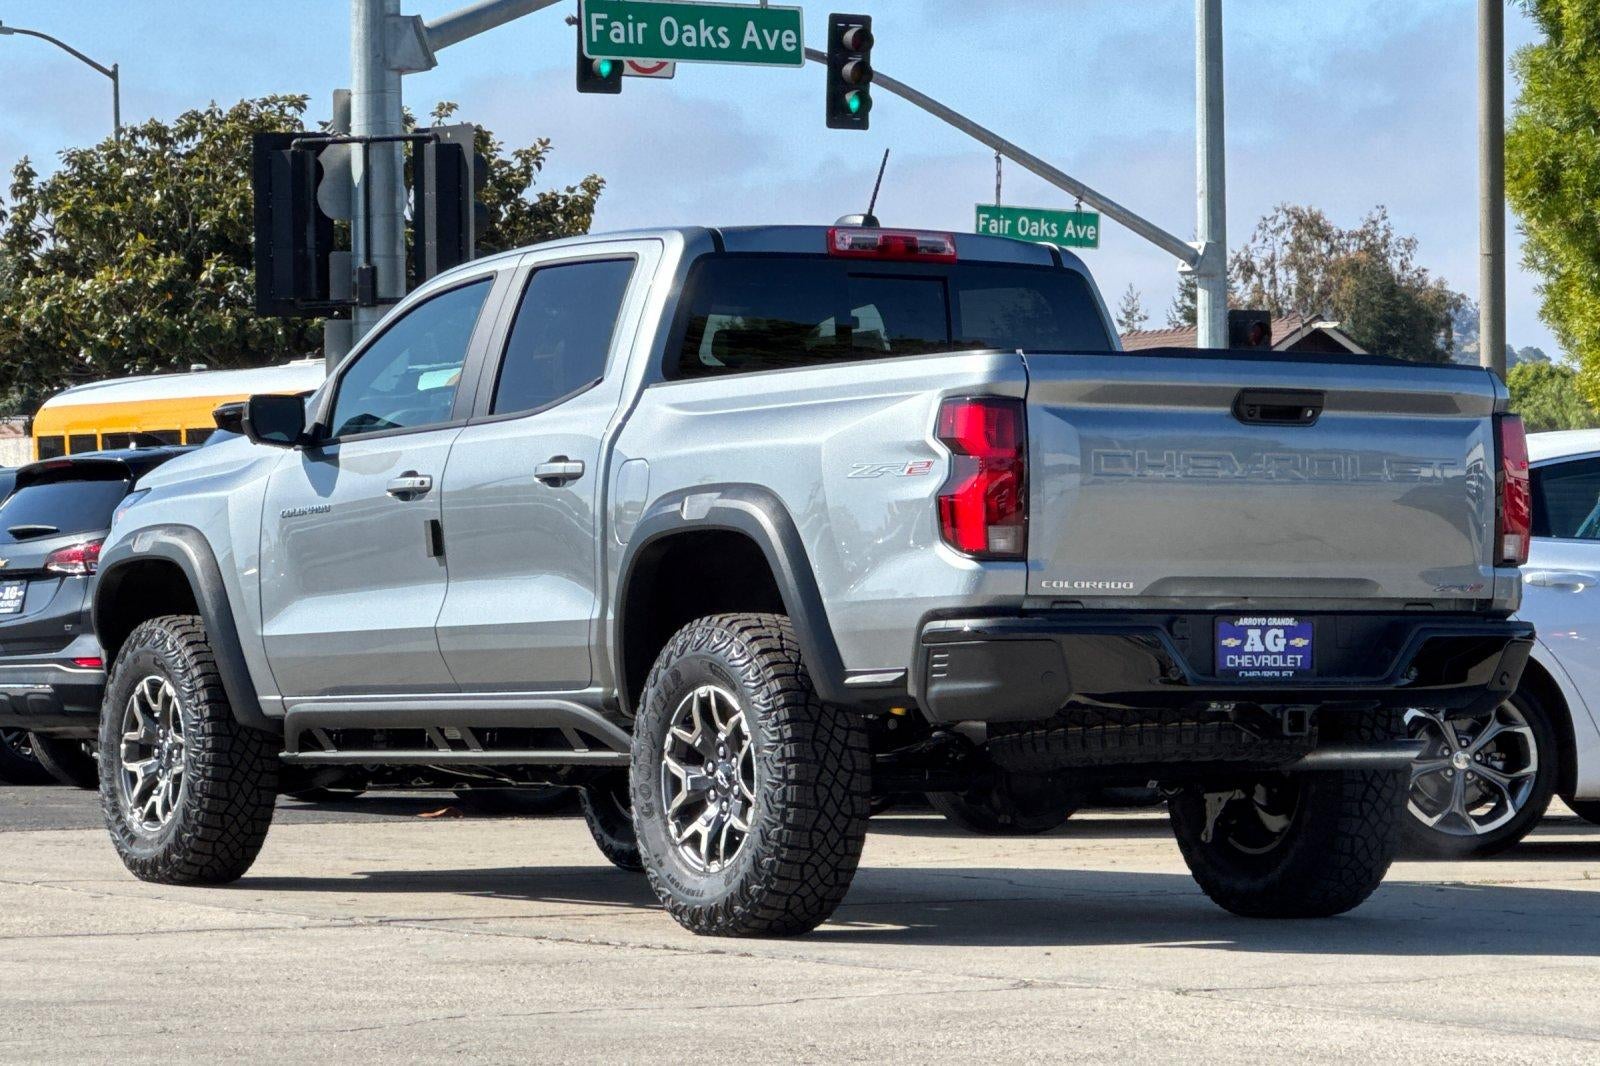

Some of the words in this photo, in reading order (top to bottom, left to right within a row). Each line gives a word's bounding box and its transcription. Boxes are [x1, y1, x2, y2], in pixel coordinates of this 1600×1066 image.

[590, 13, 648, 44] Fair
[660, 16, 731, 49] Oaks
[741, 20, 797, 51] Ave
[978, 213, 1012, 235] Fair
[1017, 216, 1058, 238] Oaks
[1063, 219, 1096, 240] Ave
[1041, 580, 1134, 589] COLORADO
[1238, 617, 1267, 626] ARROYO
[1267, 617, 1295, 626] GRANDE
[1244, 628, 1287, 652] AG
[1226, 654, 1303, 667] CHEVROLET
